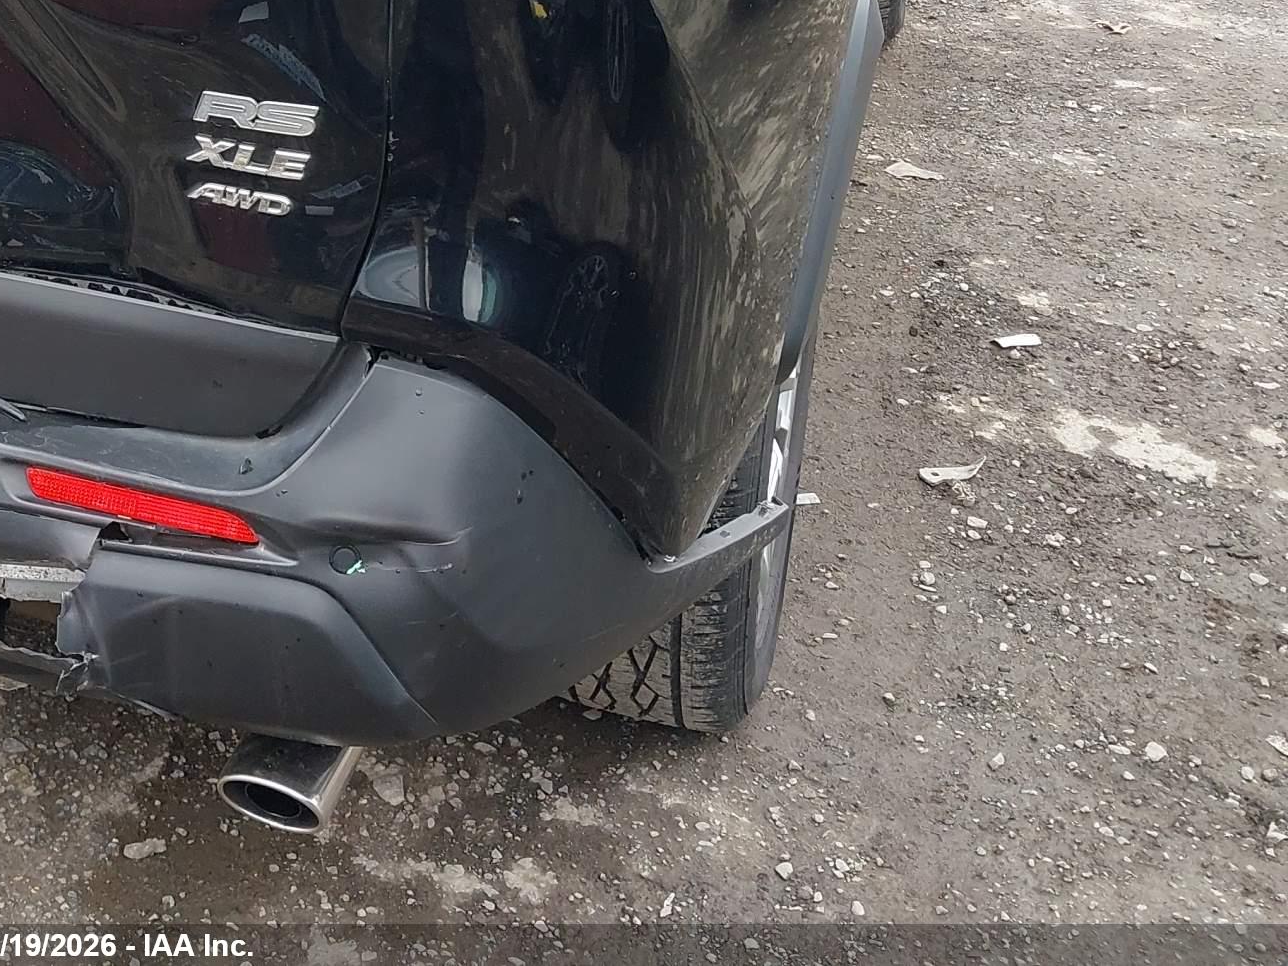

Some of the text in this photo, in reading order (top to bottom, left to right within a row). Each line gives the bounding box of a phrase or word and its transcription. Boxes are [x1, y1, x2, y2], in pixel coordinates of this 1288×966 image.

[192, 90, 319, 136] RS
[185, 134, 311, 181] XLE
[186, 182, 293, 215] AWD
